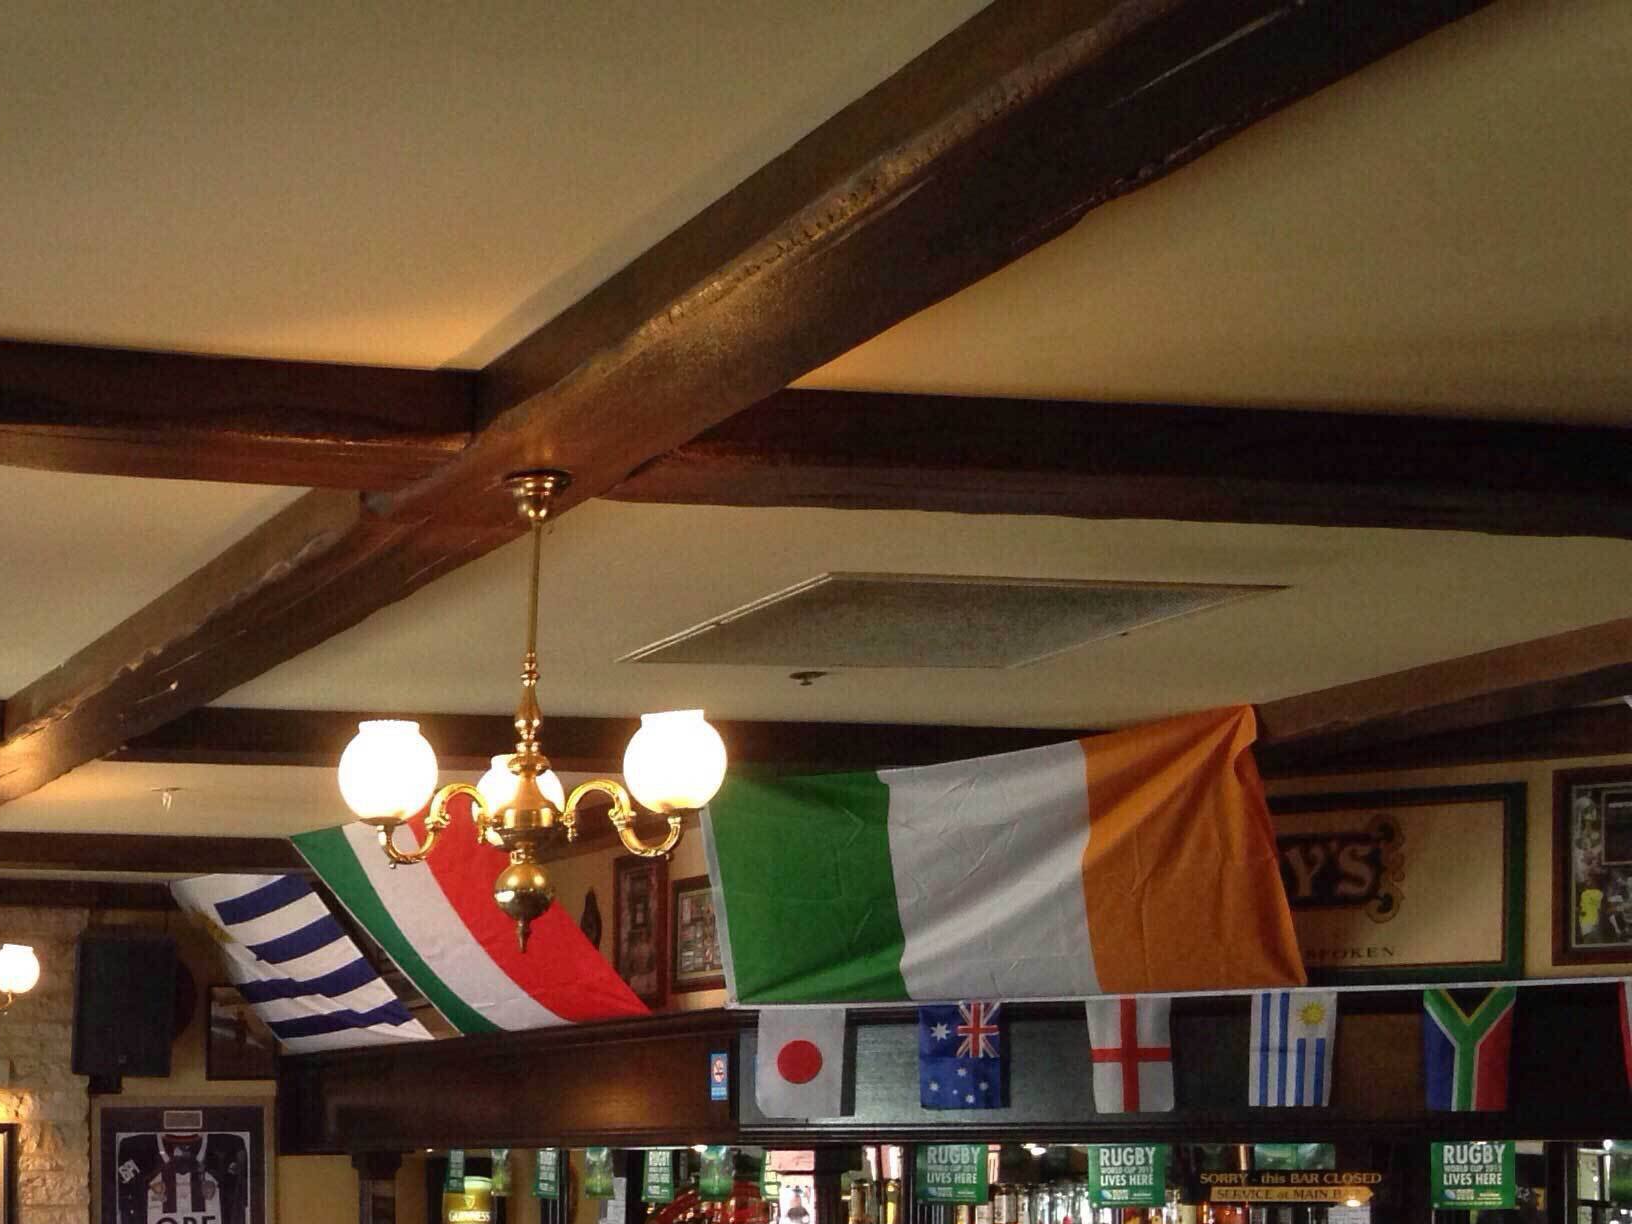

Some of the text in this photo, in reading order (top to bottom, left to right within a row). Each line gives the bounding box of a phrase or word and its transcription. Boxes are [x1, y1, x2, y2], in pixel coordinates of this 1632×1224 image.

[1284, 842, 1375, 897] Y'S
[927, 1146, 981, 1165] RUGBY
[1099, 1146, 1156, 1166] RUGBY
[1443, 1144, 1506, 1165] RUGBY
[927, 1172, 977, 1185] LIVES HERE
[1100, 1174, 1154, 1187] LIVES HERE
[1200, 1173, 1248, 1185] SORRY
[1261, 1172, 1286, 1185] this
[1290, 1172, 1319, 1185] BAR
[1323, 1172, 1383, 1185] CLOSED
[1443, 1172, 1503, 1185] LIVES HERE
[1216, 1188, 1273, 1200] SERVICE
[1292, 1188, 1328, 1199] MAIN
[448, 1210, 490, 1222] GUINNESS
